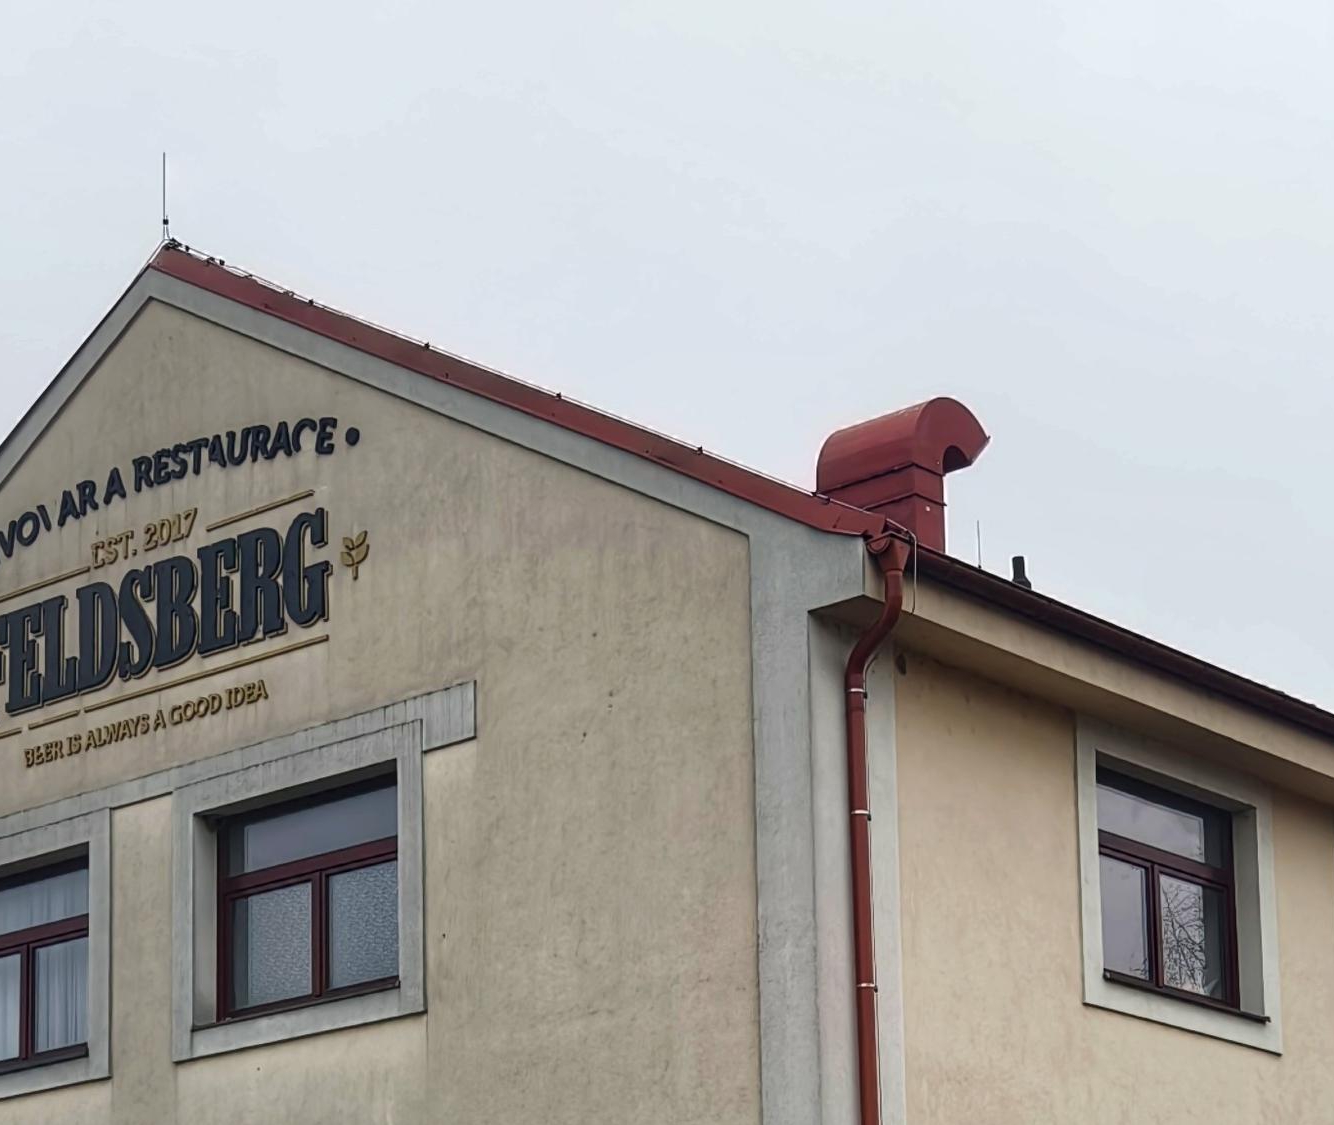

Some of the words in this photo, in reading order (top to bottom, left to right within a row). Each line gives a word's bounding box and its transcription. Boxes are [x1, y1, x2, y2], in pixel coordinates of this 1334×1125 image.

[103, 467, 127, 505] A
[132, 417, 338, 494] RESTAURACE
[143, 507, 198, 553] 2017
[23, 739, 65, 768] BEER
[66, 734, 83, 757] IS
[84, 713, 151, 752] ALWAYS
[153, 708, 166, 732] A
[169, 692, 224, 726] GOOD
[225, 679, 269, 711] IDEA
